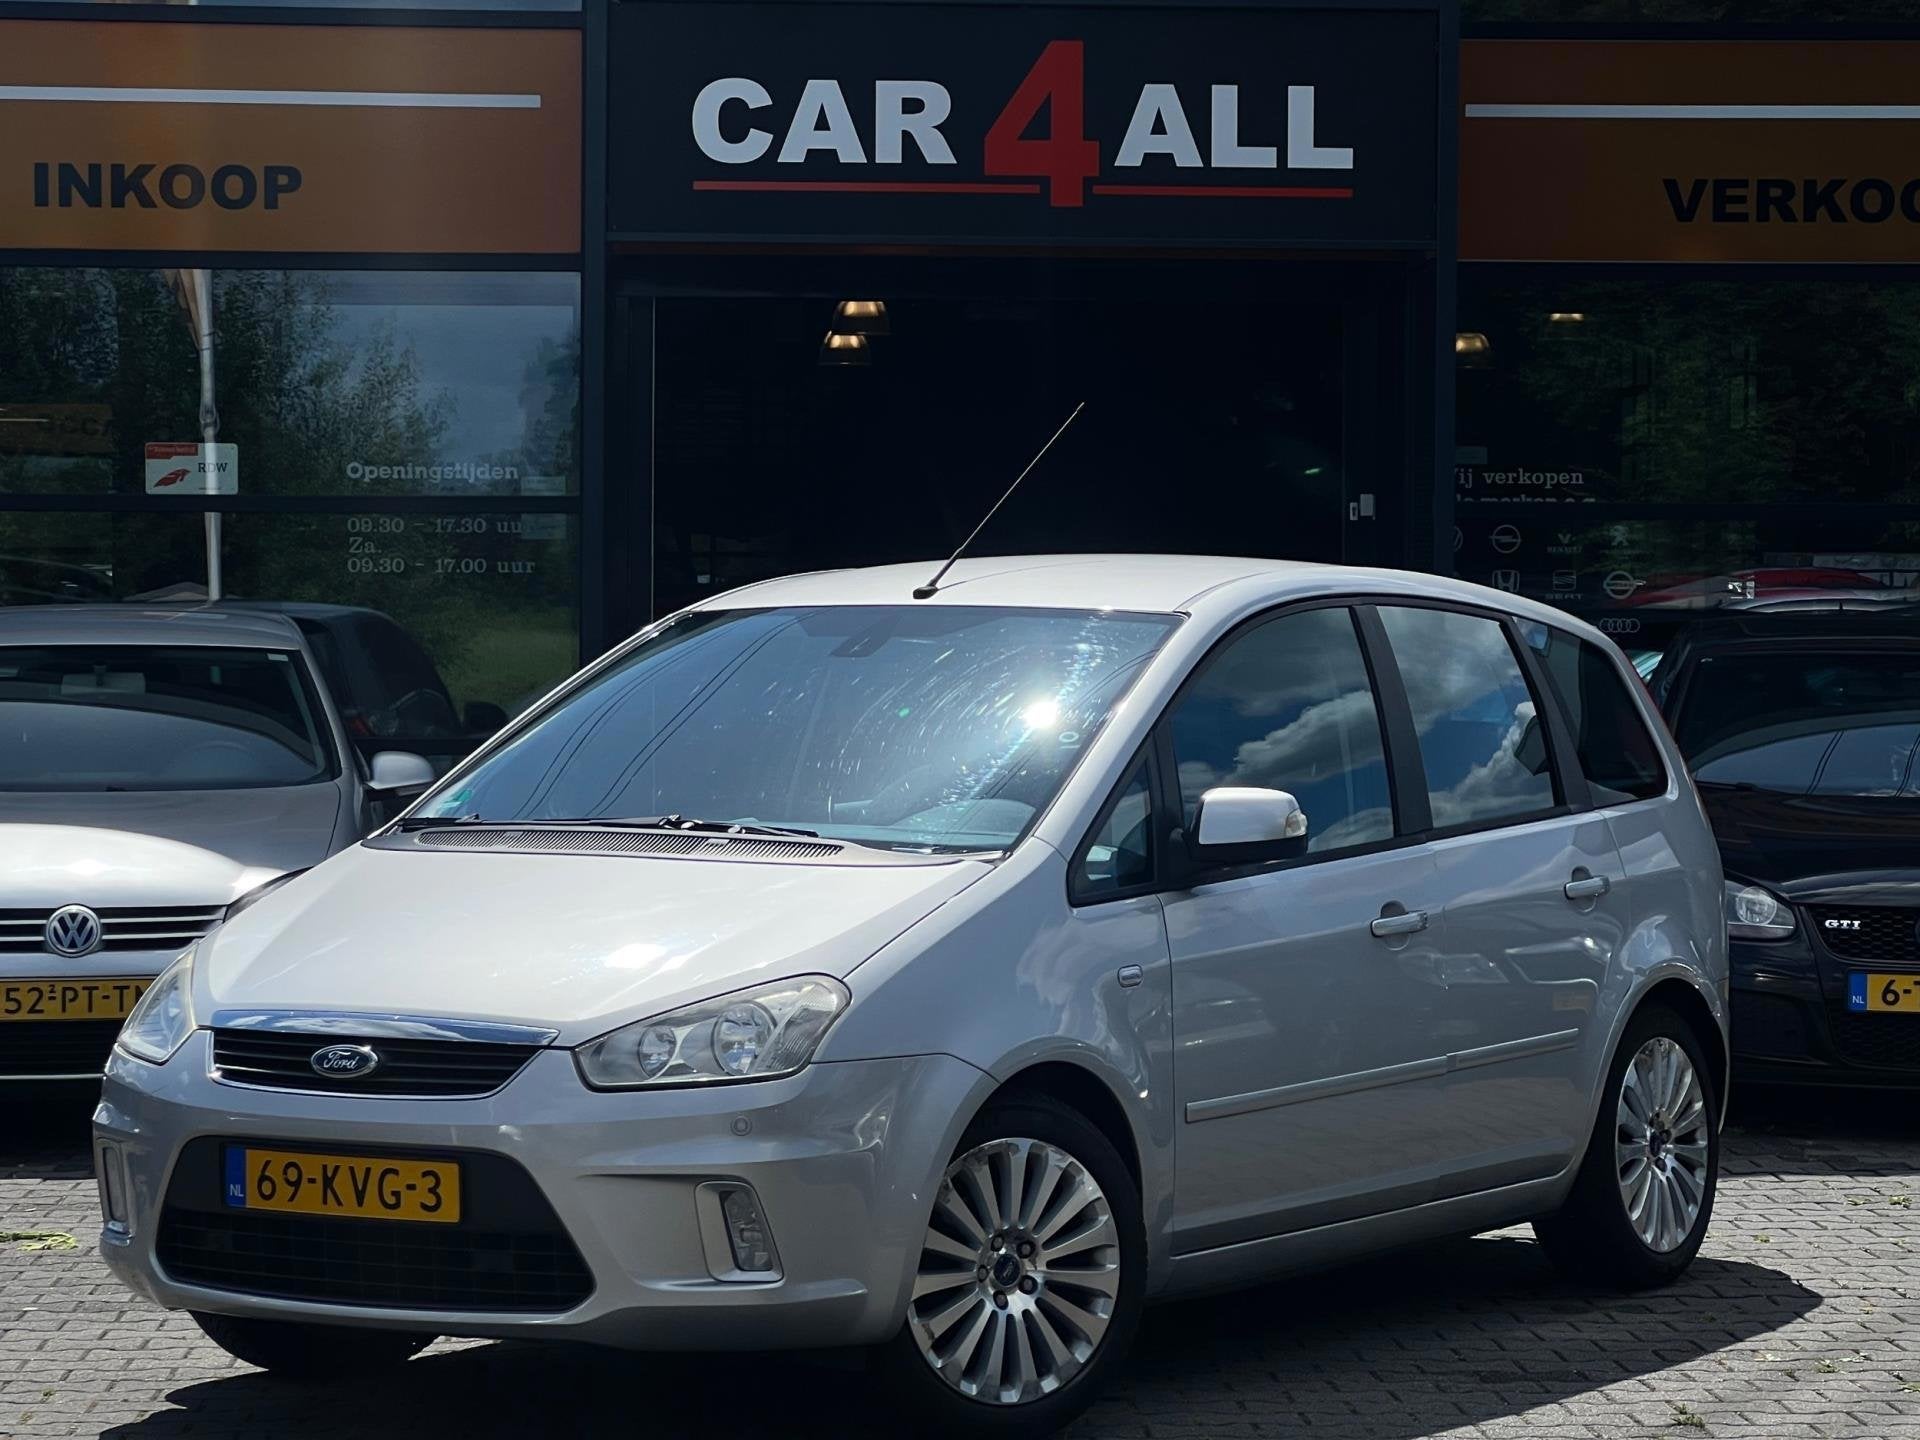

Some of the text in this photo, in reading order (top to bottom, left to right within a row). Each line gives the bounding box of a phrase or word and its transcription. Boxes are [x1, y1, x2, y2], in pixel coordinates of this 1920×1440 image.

[691, 39, 1354, 208] CAR 4 ALL
[33, 162, 303, 210] INKOOP
[197, 462, 229, 473] RDW
[346, 461, 519, 483] Openingstijden
[1483, 467, 1585, 488] verkopen
[434, 517, 487, 534] 17.30
[348, 536, 383, 554] Za.
[346, 558, 405, 574] 09.30
[435, 558, 487, 574] 17.00
[497, 561, 536, 574] uur
[1824, 919, 1862, 930] GTI
[1852, 995, 1865, 1004] NL
[323, 1050, 360, 1070] Ford
[229, 1184, 244, 1197] NL
[256, 1159, 443, 1214] 69-KVG-3
